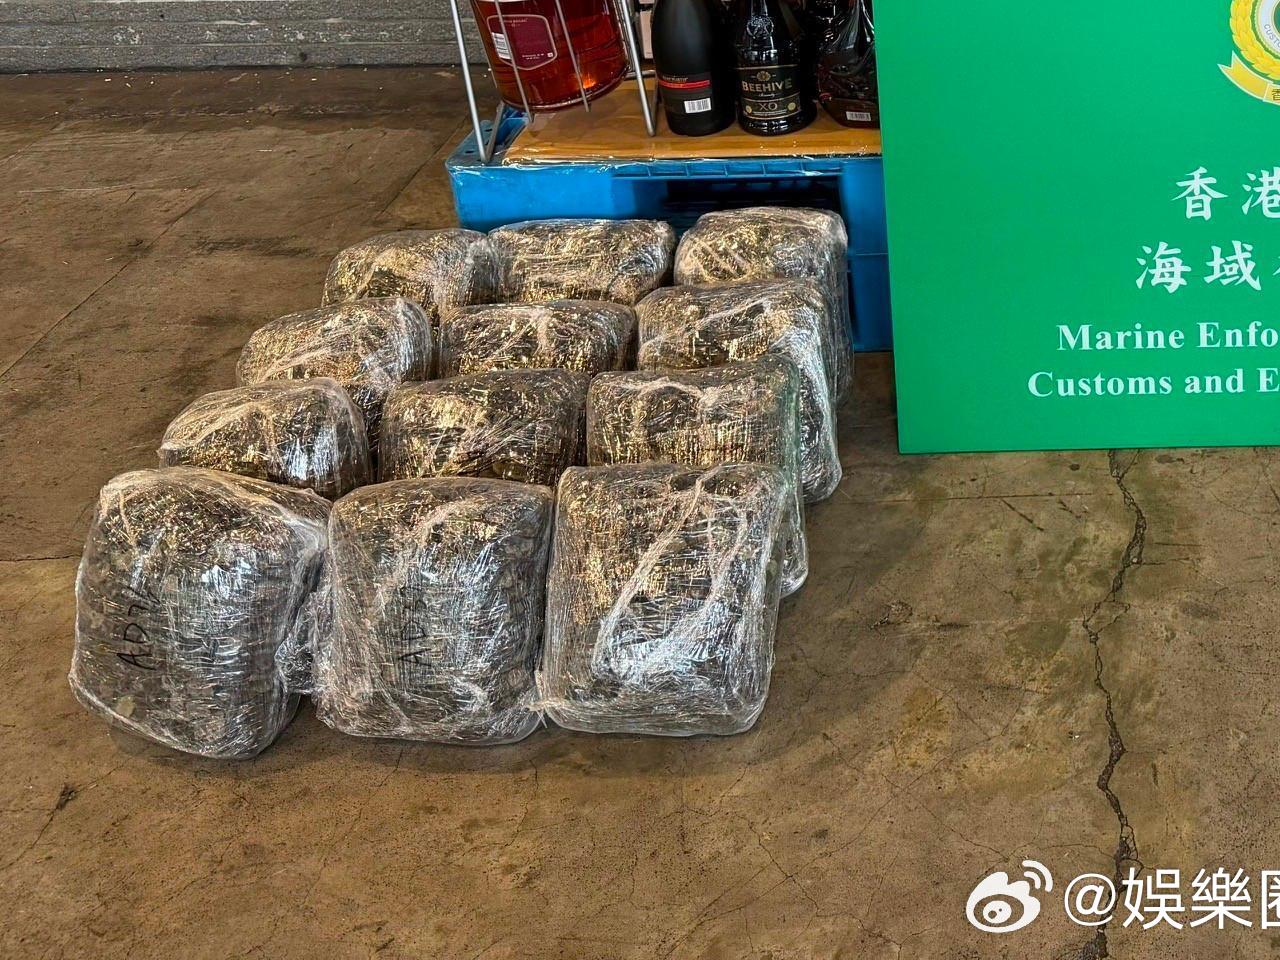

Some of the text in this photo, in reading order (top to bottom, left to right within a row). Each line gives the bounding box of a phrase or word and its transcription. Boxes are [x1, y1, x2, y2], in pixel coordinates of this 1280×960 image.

[742, 78, 792, 92] BEEHIVE
[759, 102, 777, 110] XO
[1056, 323, 1185, 350] Marine
[1027, 370, 1173, 397] Customs
[1184, 368, 1243, 394] and
